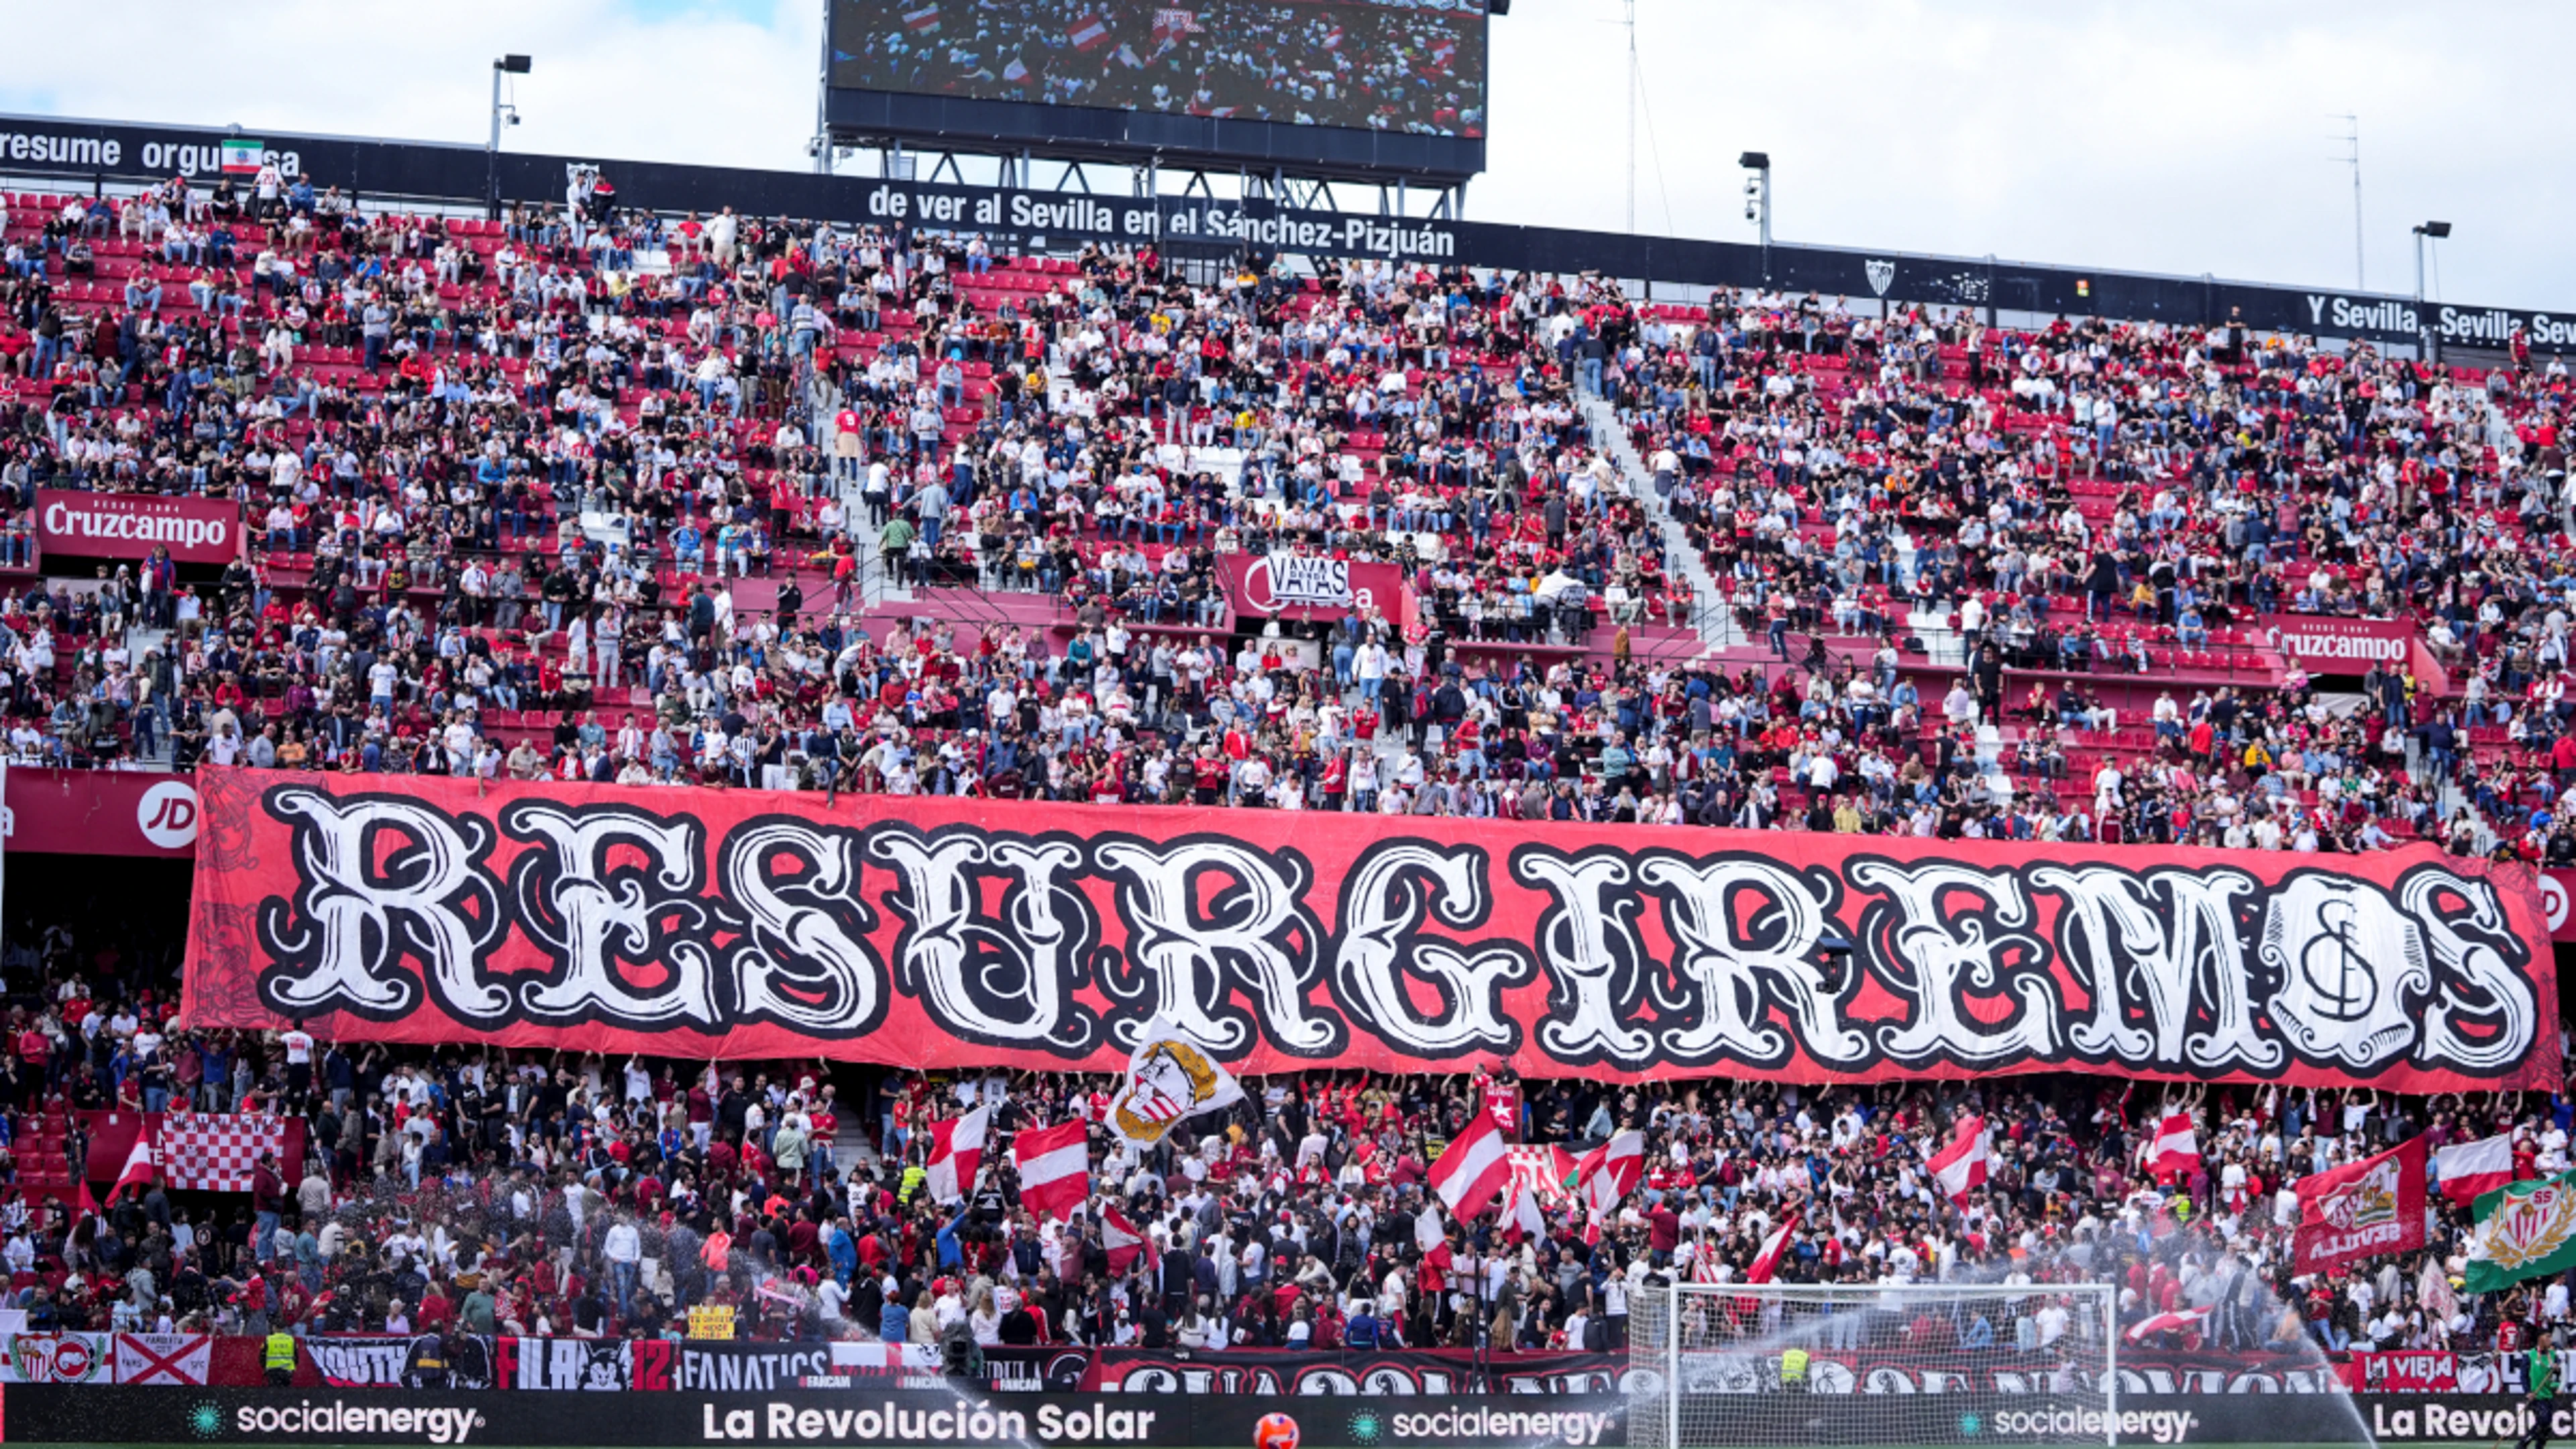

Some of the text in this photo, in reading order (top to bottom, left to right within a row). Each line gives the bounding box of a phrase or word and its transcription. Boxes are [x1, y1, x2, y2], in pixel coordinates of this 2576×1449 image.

[142, 142, 300, 177] orgusa
[869, 184, 1454, 258] de ver al Sevilla en el Sánchez-Pizjuán
[2307, 295, 2326, 324] Y
[45, 500, 226, 548] Cruzcampo
[147, 798, 196, 830] JD
[267, 788, 2539, 1076] RESURGIREMOS
[496, 1337, 578, 1391] FILA
[683, 1350, 827, 1391] FANATICS
[2393, 1356, 2453, 1385] VIEJA
[704, 1399, 1155, 1440] La Revolución Solar
[2373, 1403, 2416, 1437] La
